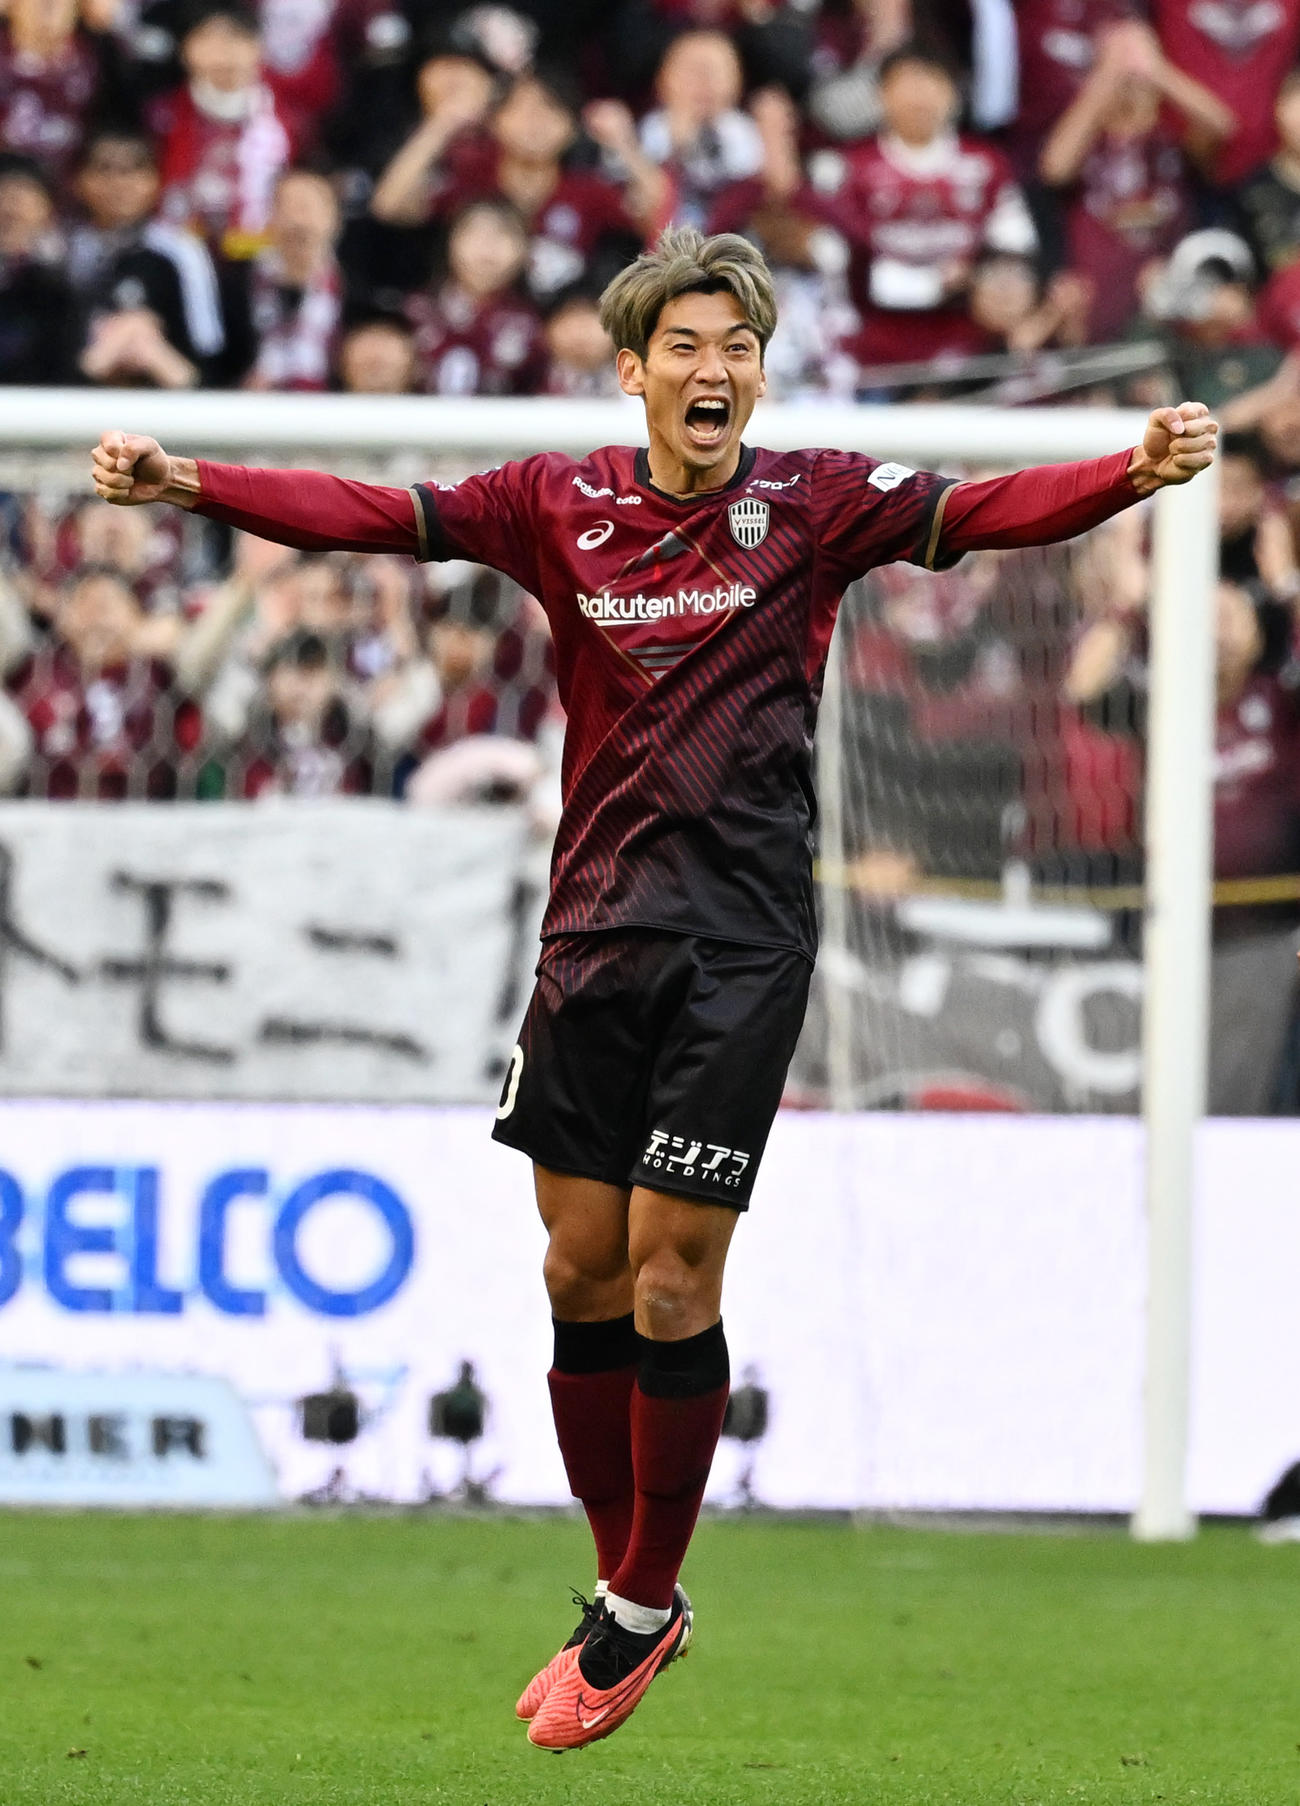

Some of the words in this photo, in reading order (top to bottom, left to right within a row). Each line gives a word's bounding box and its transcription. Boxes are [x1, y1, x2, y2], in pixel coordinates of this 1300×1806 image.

[576, 591, 675, 619] Rakuten
[678, 581, 757, 614] Mobile
[642, 1154, 741, 1188] HOLDINGS
[645, 1129, 750, 1177] デジアラ
